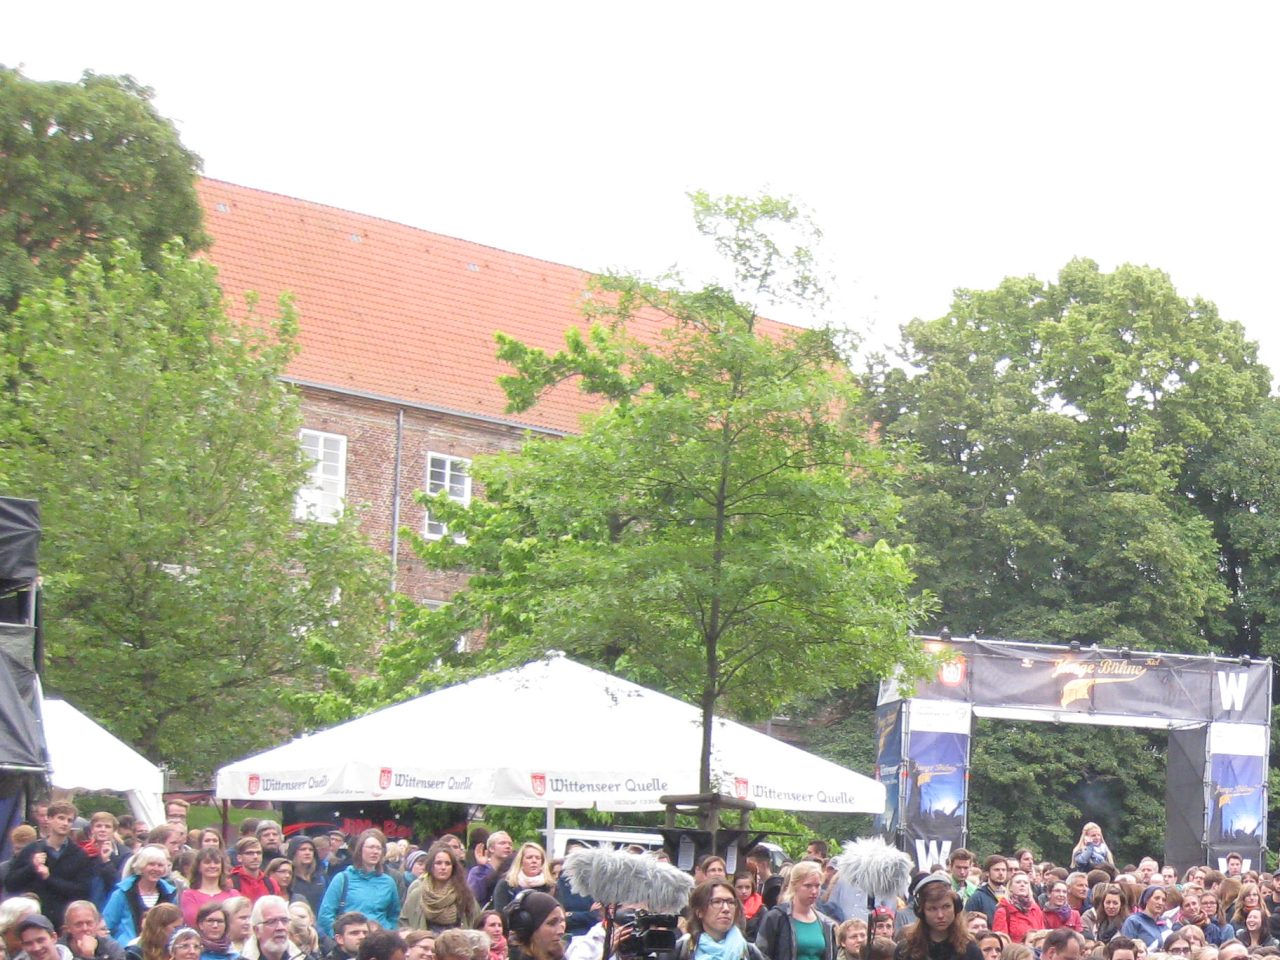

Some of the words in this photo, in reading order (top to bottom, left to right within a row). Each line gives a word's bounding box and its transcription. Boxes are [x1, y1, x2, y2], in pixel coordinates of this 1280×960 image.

[1098, 658, 1142, 675] Bühne
[1217, 670, 1249, 712] W
[262, 778, 307, 792] Wittenseer
[394, 773, 446, 790] Wittenseer
[447, 776, 474, 790] Quelle
[549, 777, 622, 793] Wittenseer
[624, 777, 669, 793] Quelle
[751, 784, 815, 802] Wittenseer
[816, 789, 856, 805] Quelle
